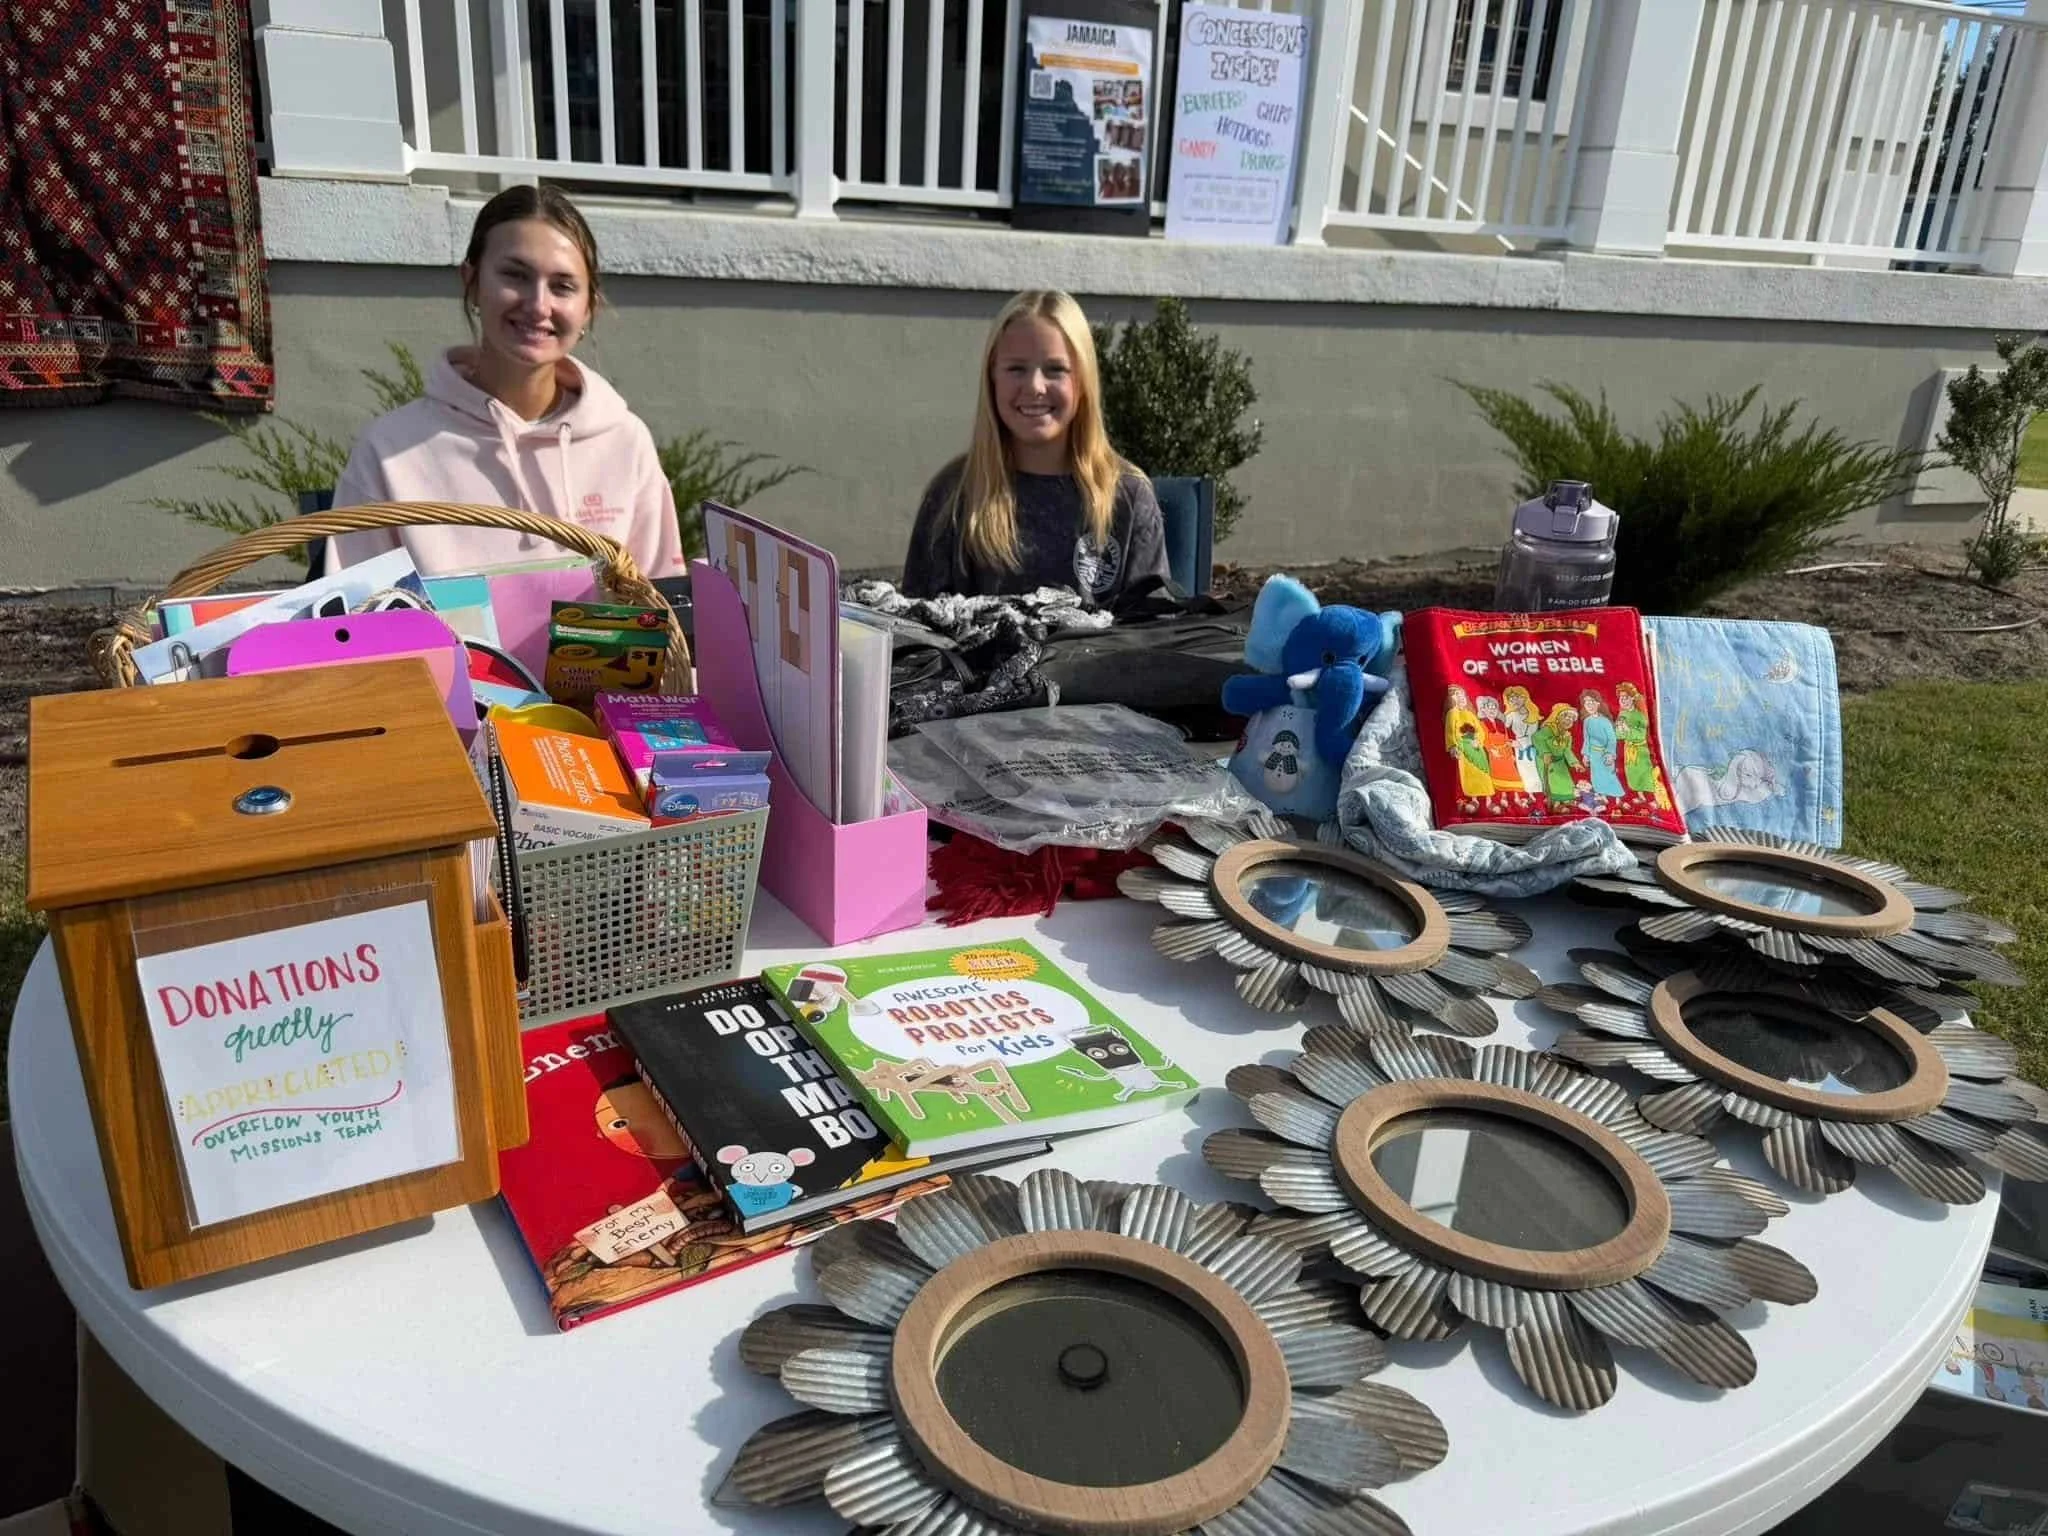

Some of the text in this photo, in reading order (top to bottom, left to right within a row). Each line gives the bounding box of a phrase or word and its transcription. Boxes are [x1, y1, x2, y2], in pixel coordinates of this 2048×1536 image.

[1066, 24, 1117, 48] JAMAICA
[1187, 11, 1307, 57] CONCESSIONS
[1256, 101, 1293, 125] CHIPS
[1488, 640, 1571, 657] WOMEN
[1462, 656, 1606, 676] OF THE BIBLE
[607, 693, 699, 704] Math War
[533, 823, 561, 836] BASIC
[157, 943, 382, 1028] DONATIONS
[892, 981, 988, 1003] AWESOME
[703, 1003, 766, 1036] DO
[887, 990, 1031, 1025] ROBOTICS
[223, 1005, 355, 1064] greatly
[904, 1007, 1055, 1046] PROJECTS
[987, 1033, 1055, 1058] Kids
[769, 1049, 834, 1084] TH
[780, 1076, 857, 1118] MA
[203, 1105, 380, 1151] OVERFLOW YOUTH
[230, 1120, 383, 1164] MISSIONS TEAM
[809, 1108, 878, 1150] BO
[591, 1218, 620, 1237] For
[610, 1214, 653, 1242] Best
[611, 1217, 676, 1256] Enemy
